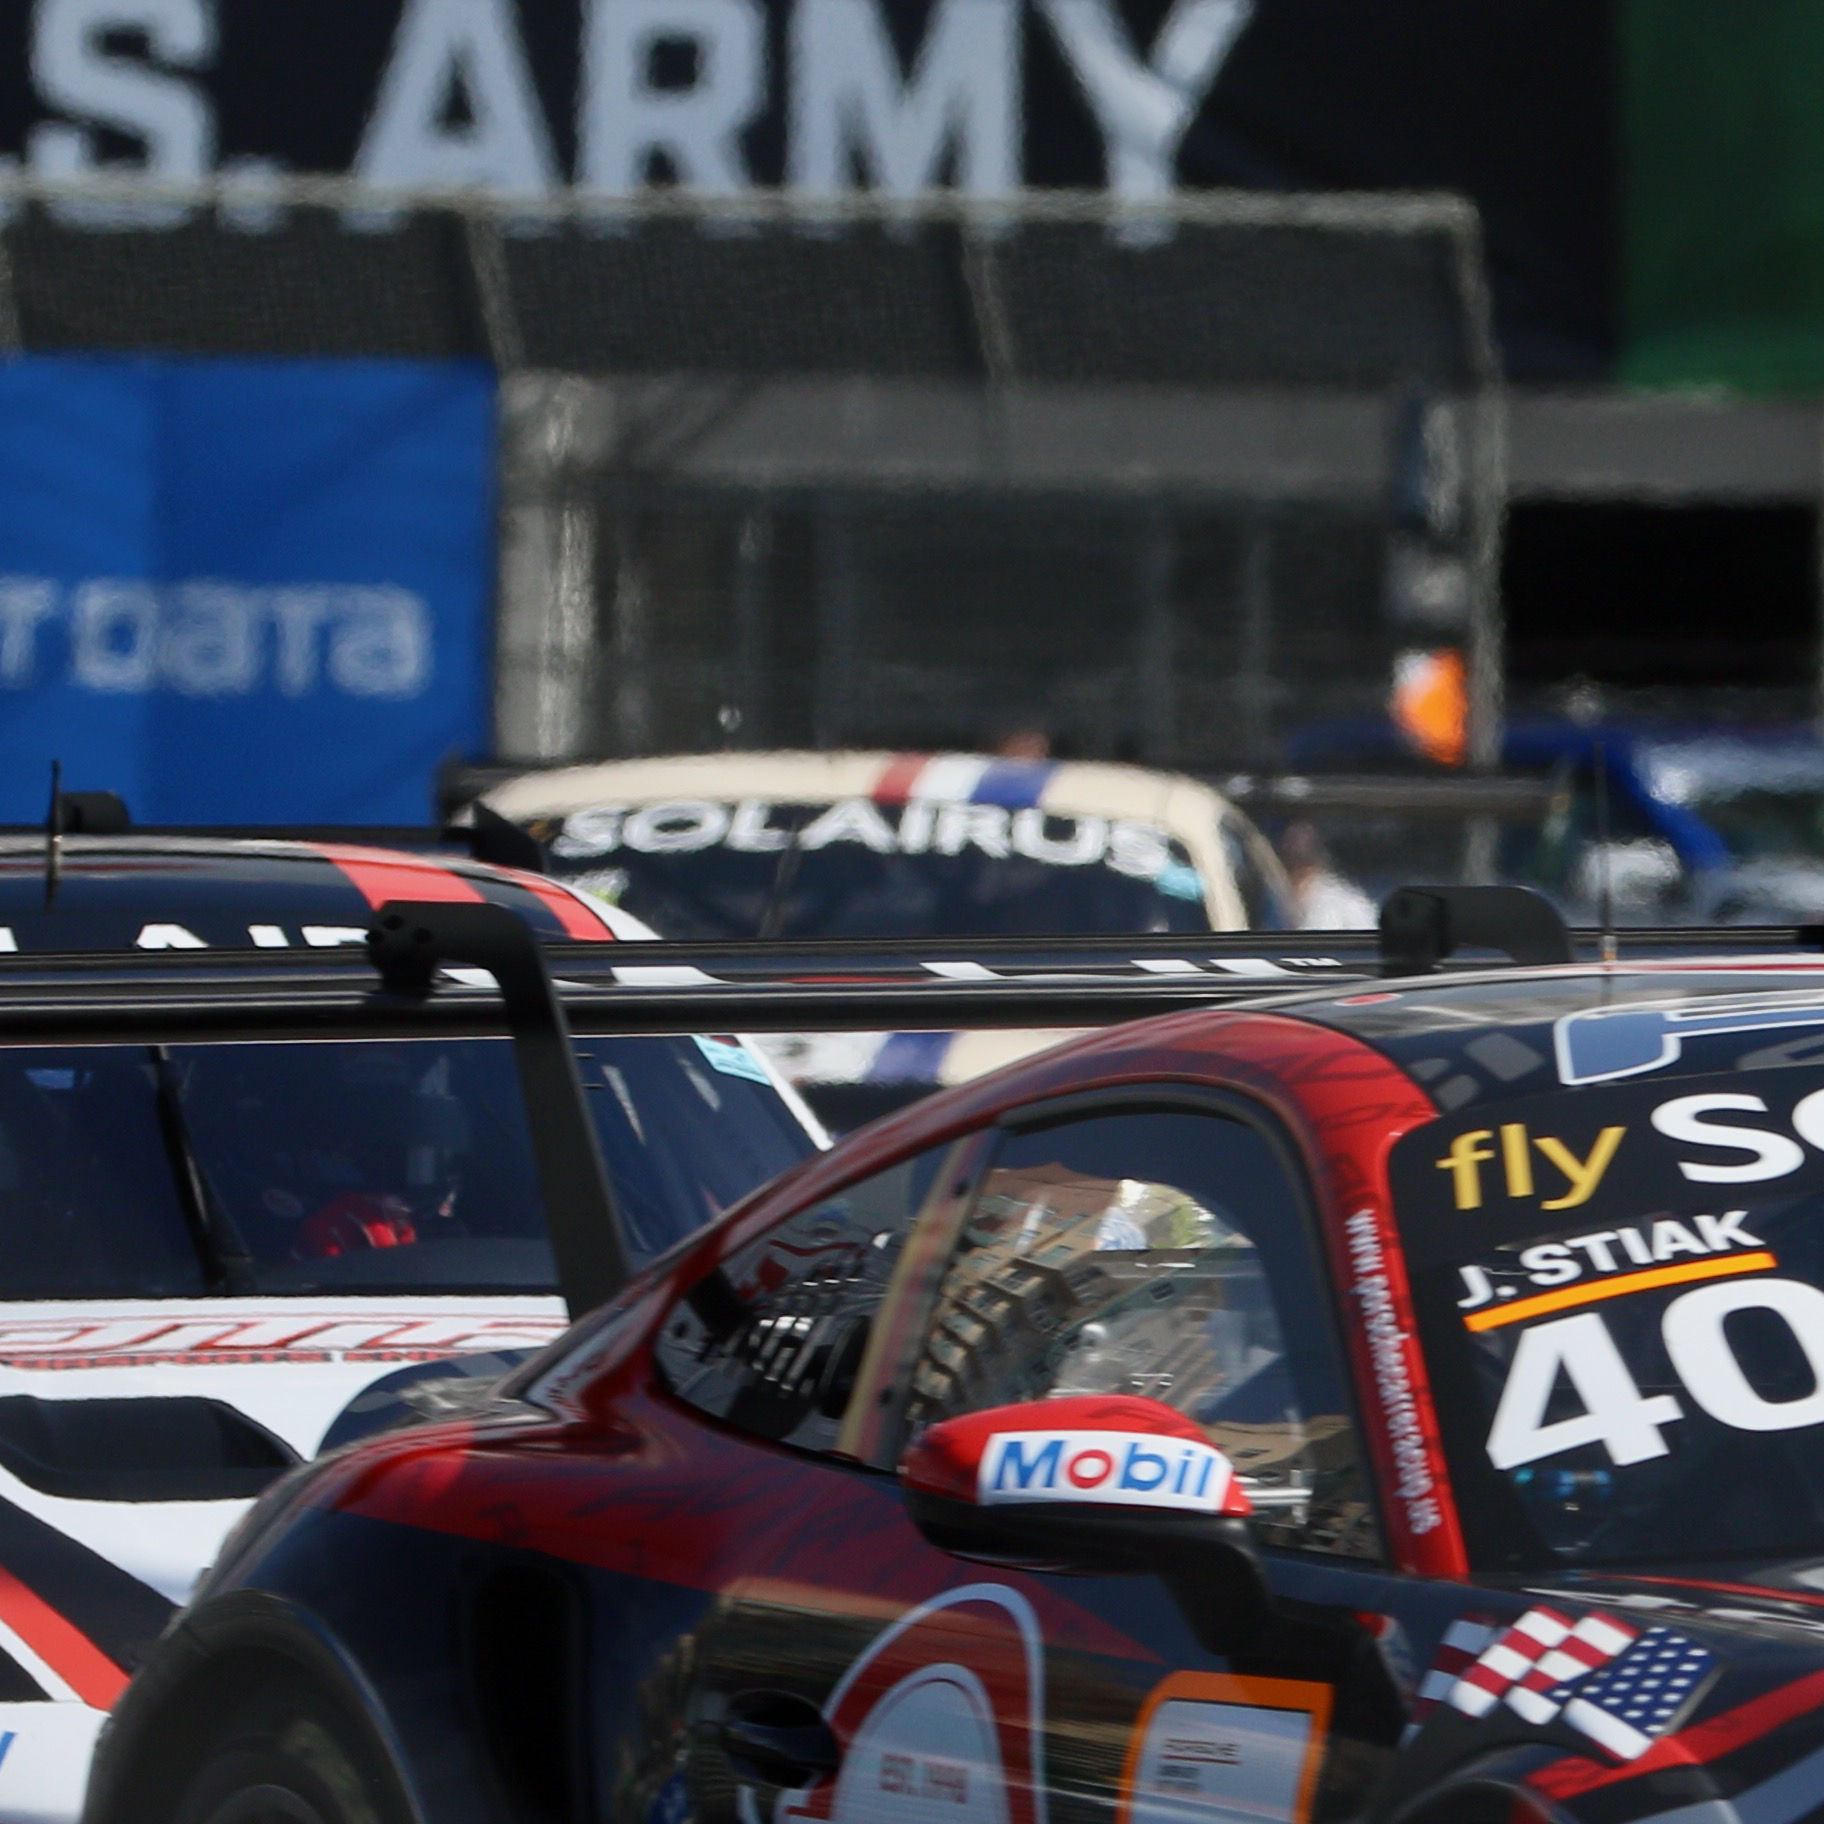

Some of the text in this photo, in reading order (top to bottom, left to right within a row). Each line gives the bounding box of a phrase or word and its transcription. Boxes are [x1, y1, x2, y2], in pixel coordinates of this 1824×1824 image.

[339, 0, 1258, 250] ARMY
[553, 796, 1188, 882] SOLAIRUS
[1436, 1122, 1628, 1211] fly
[1457, 1209, 1765, 1310] J. STIAK
[991, 1439, 1216, 1499] Mobil
